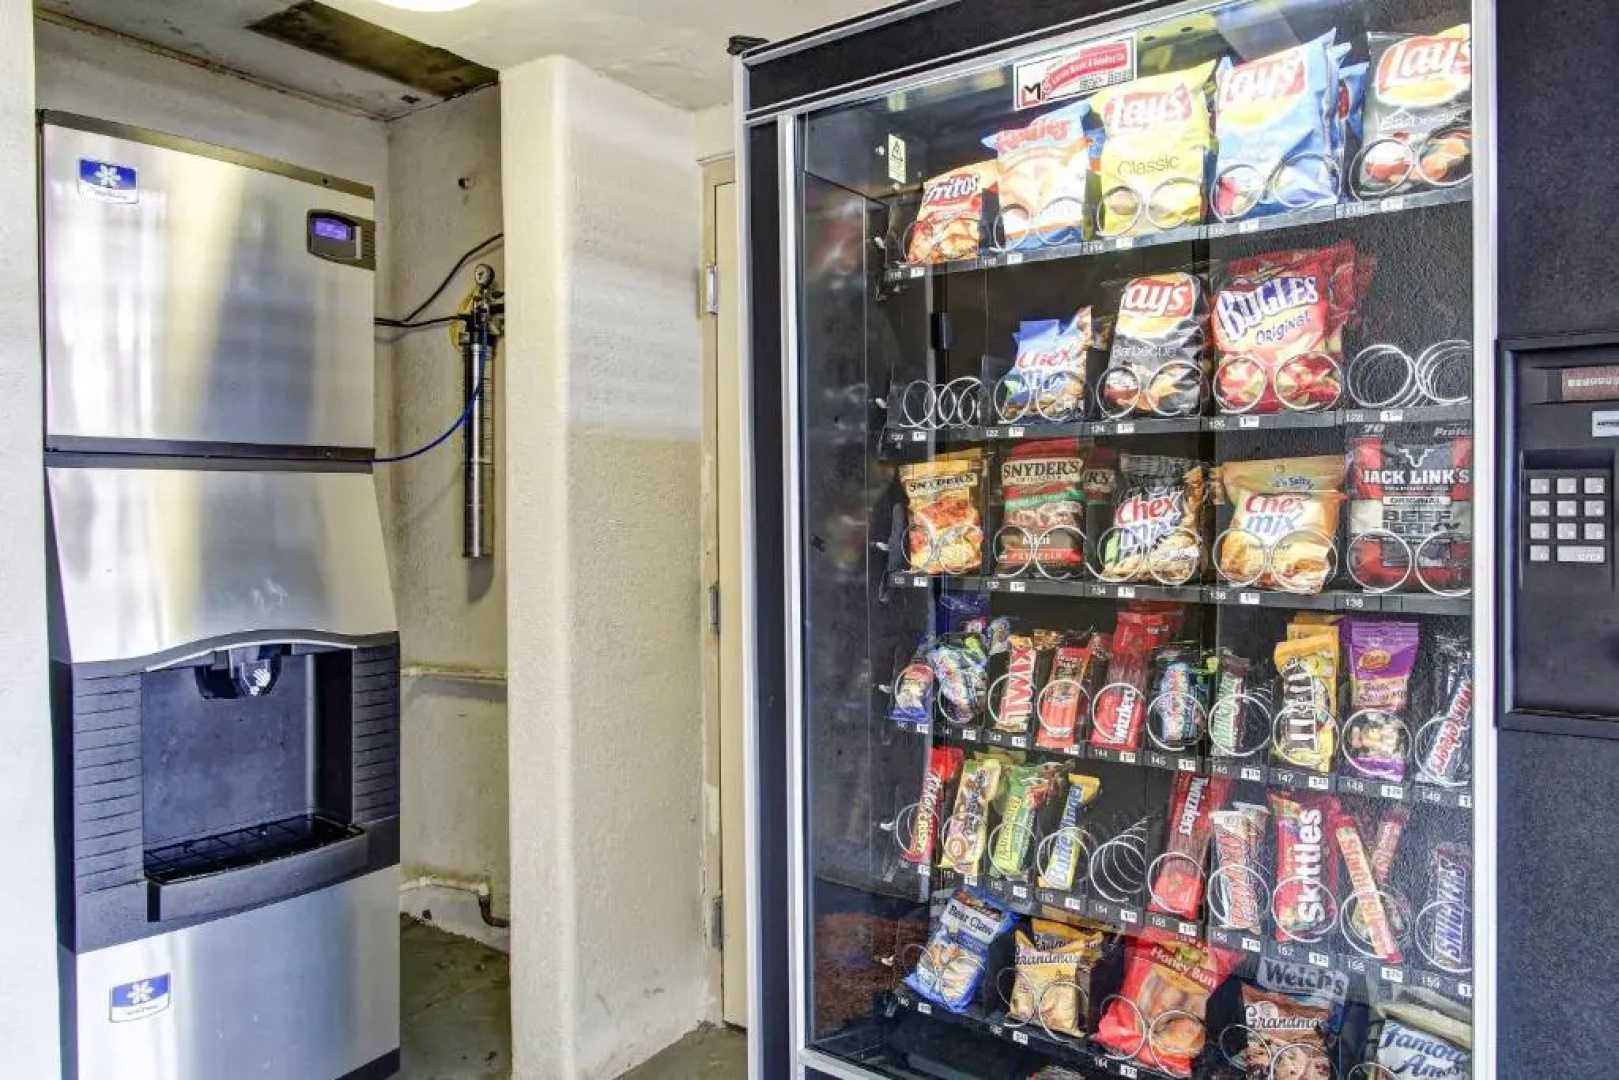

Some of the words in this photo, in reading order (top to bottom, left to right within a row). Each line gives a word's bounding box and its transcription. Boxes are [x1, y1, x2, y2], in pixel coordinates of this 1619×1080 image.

[1117, 153, 1181, 177] Classic
[1410, 467, 1470, 485] LINK'S
[1115, 492, 1181, 527] Chex
[1000, 648, 1036, 724] TWIX
[1293, 809, 1326, 923] Skittles
[948, 904, 969, 922] Bear
[1150, 945, 1190, 975] Honey
[1191, 966, 1217, 990] Bun
